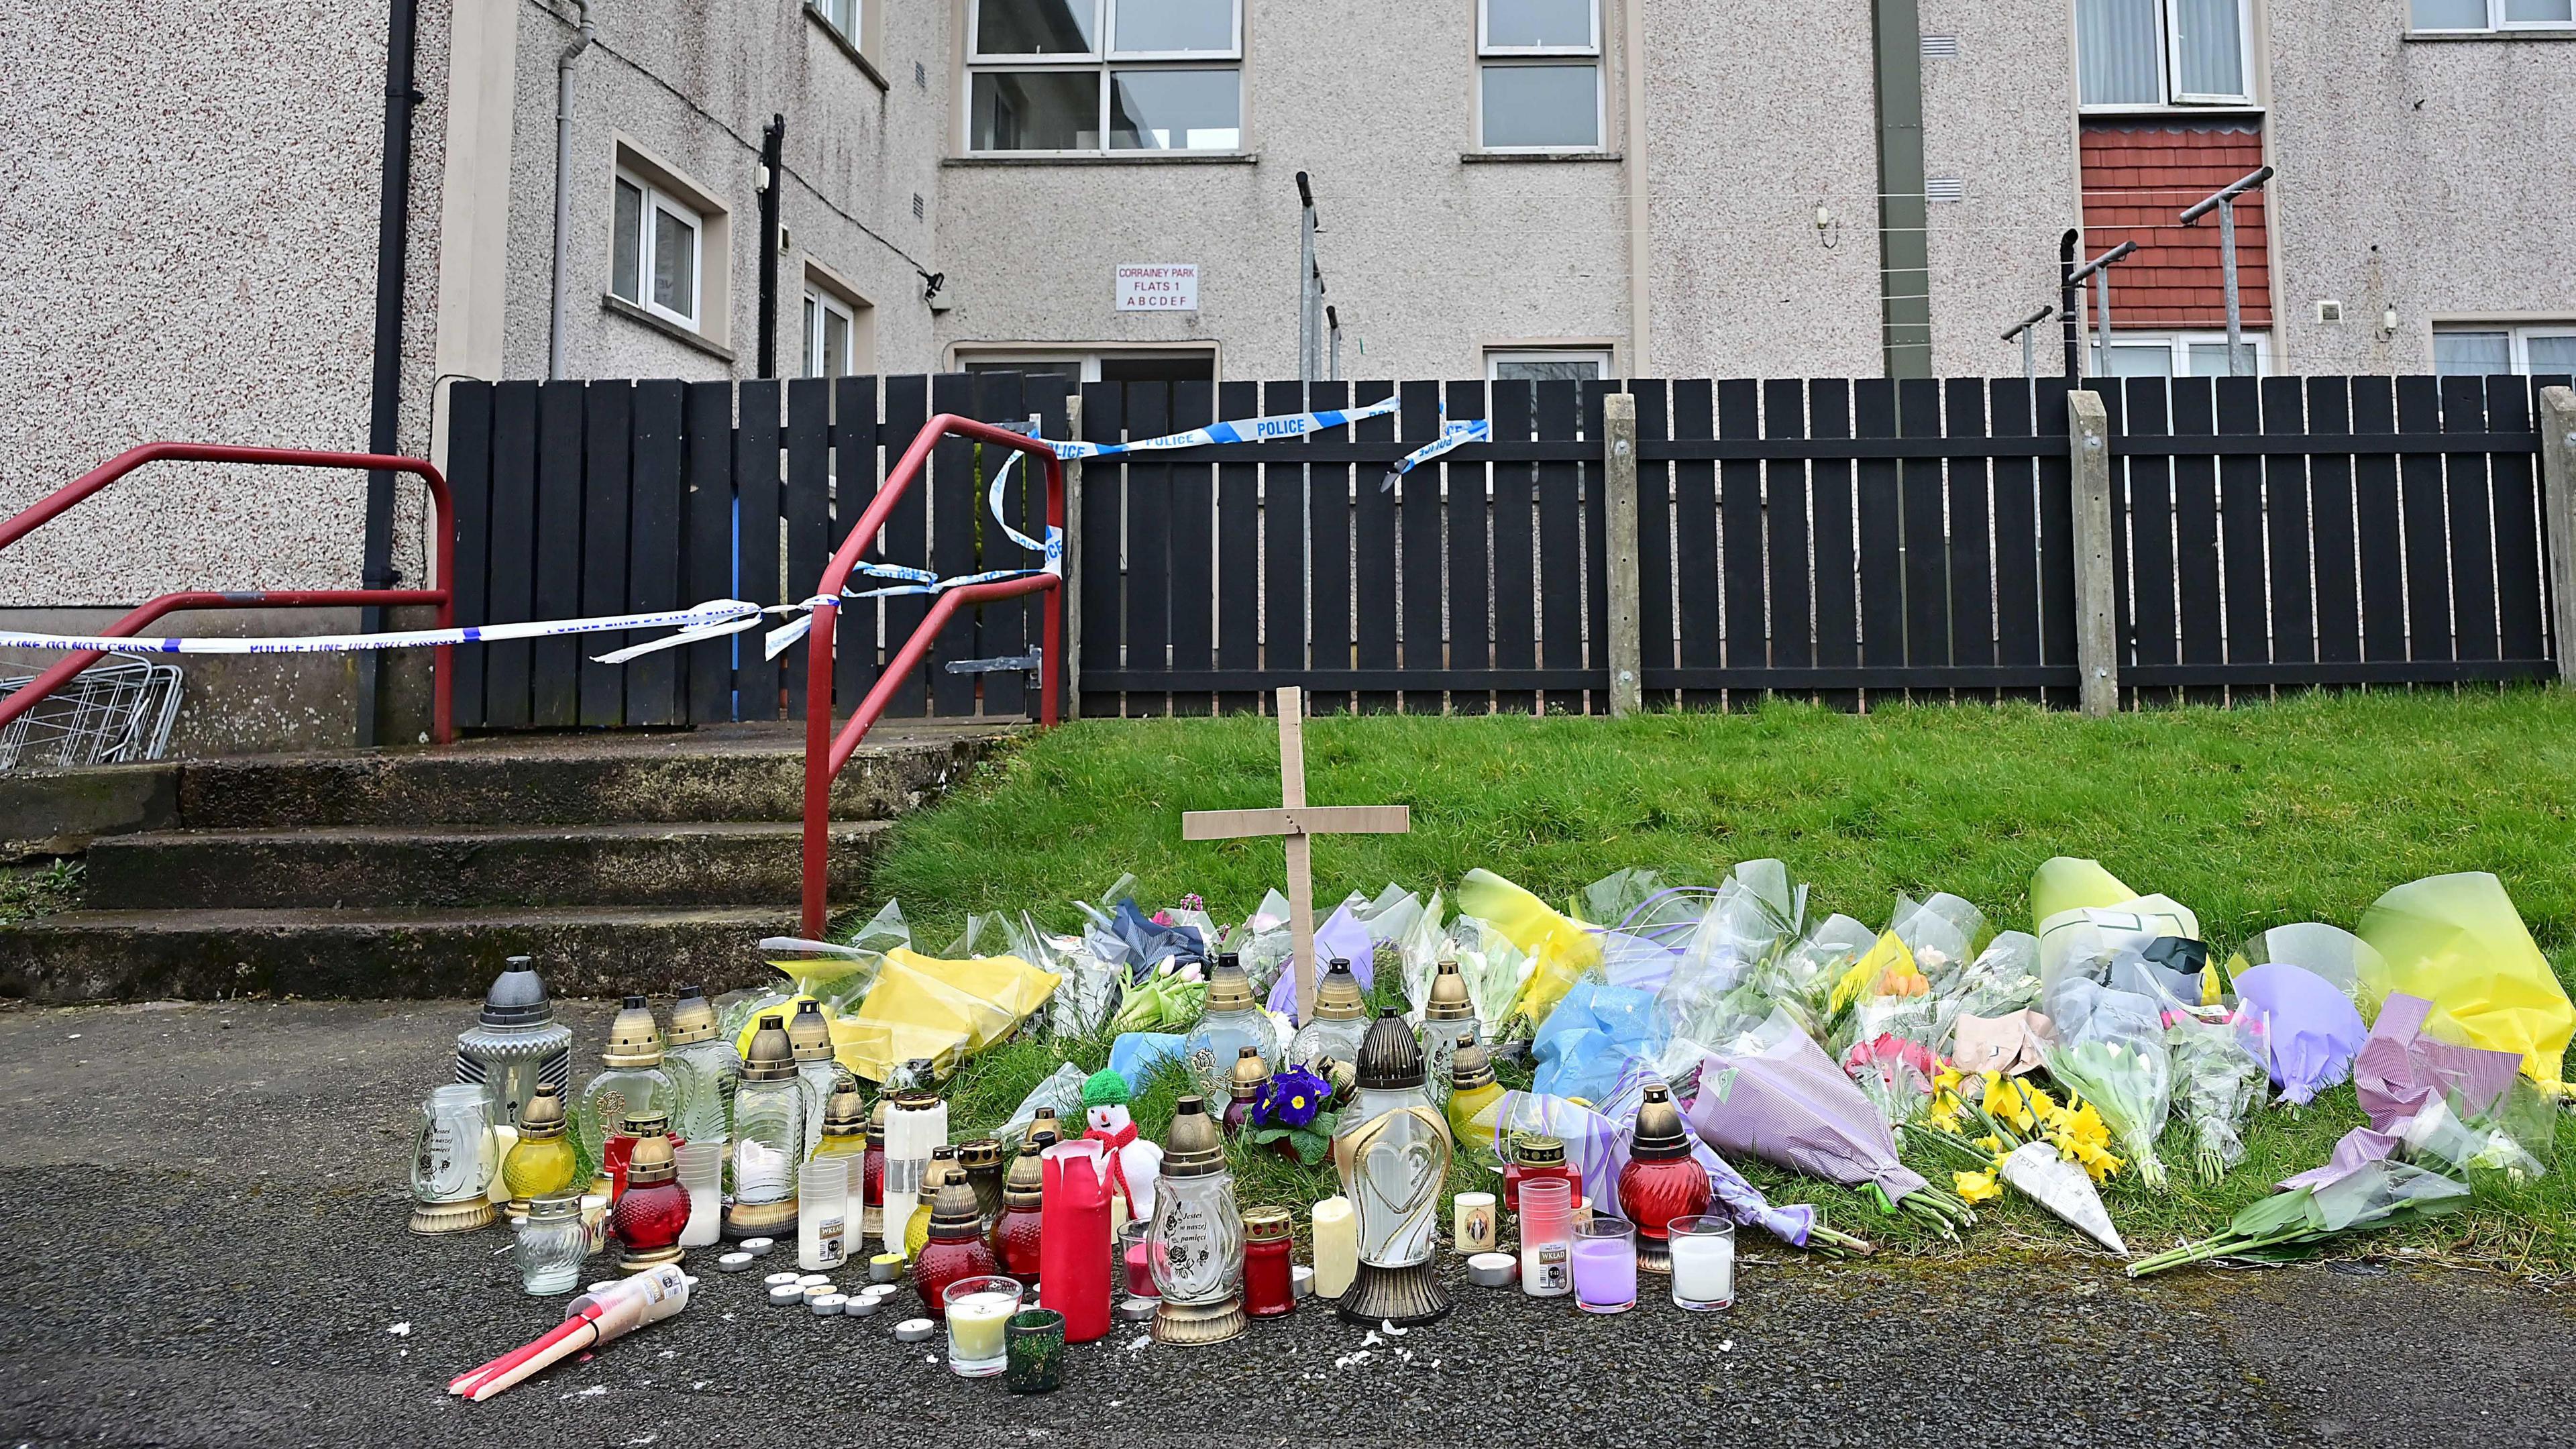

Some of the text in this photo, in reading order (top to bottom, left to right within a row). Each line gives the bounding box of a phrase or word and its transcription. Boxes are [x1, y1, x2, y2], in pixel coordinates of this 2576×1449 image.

[1119, 268, 1194, 277] CORRAINEY PARK
[1134, 282, 1179, 290] FLATS 1
[1257, 419, 1305, 436] POLICE
[1186, 1222, 1207, 1230] naszej
[1180, 1233, 1207, 1243] pamięci
